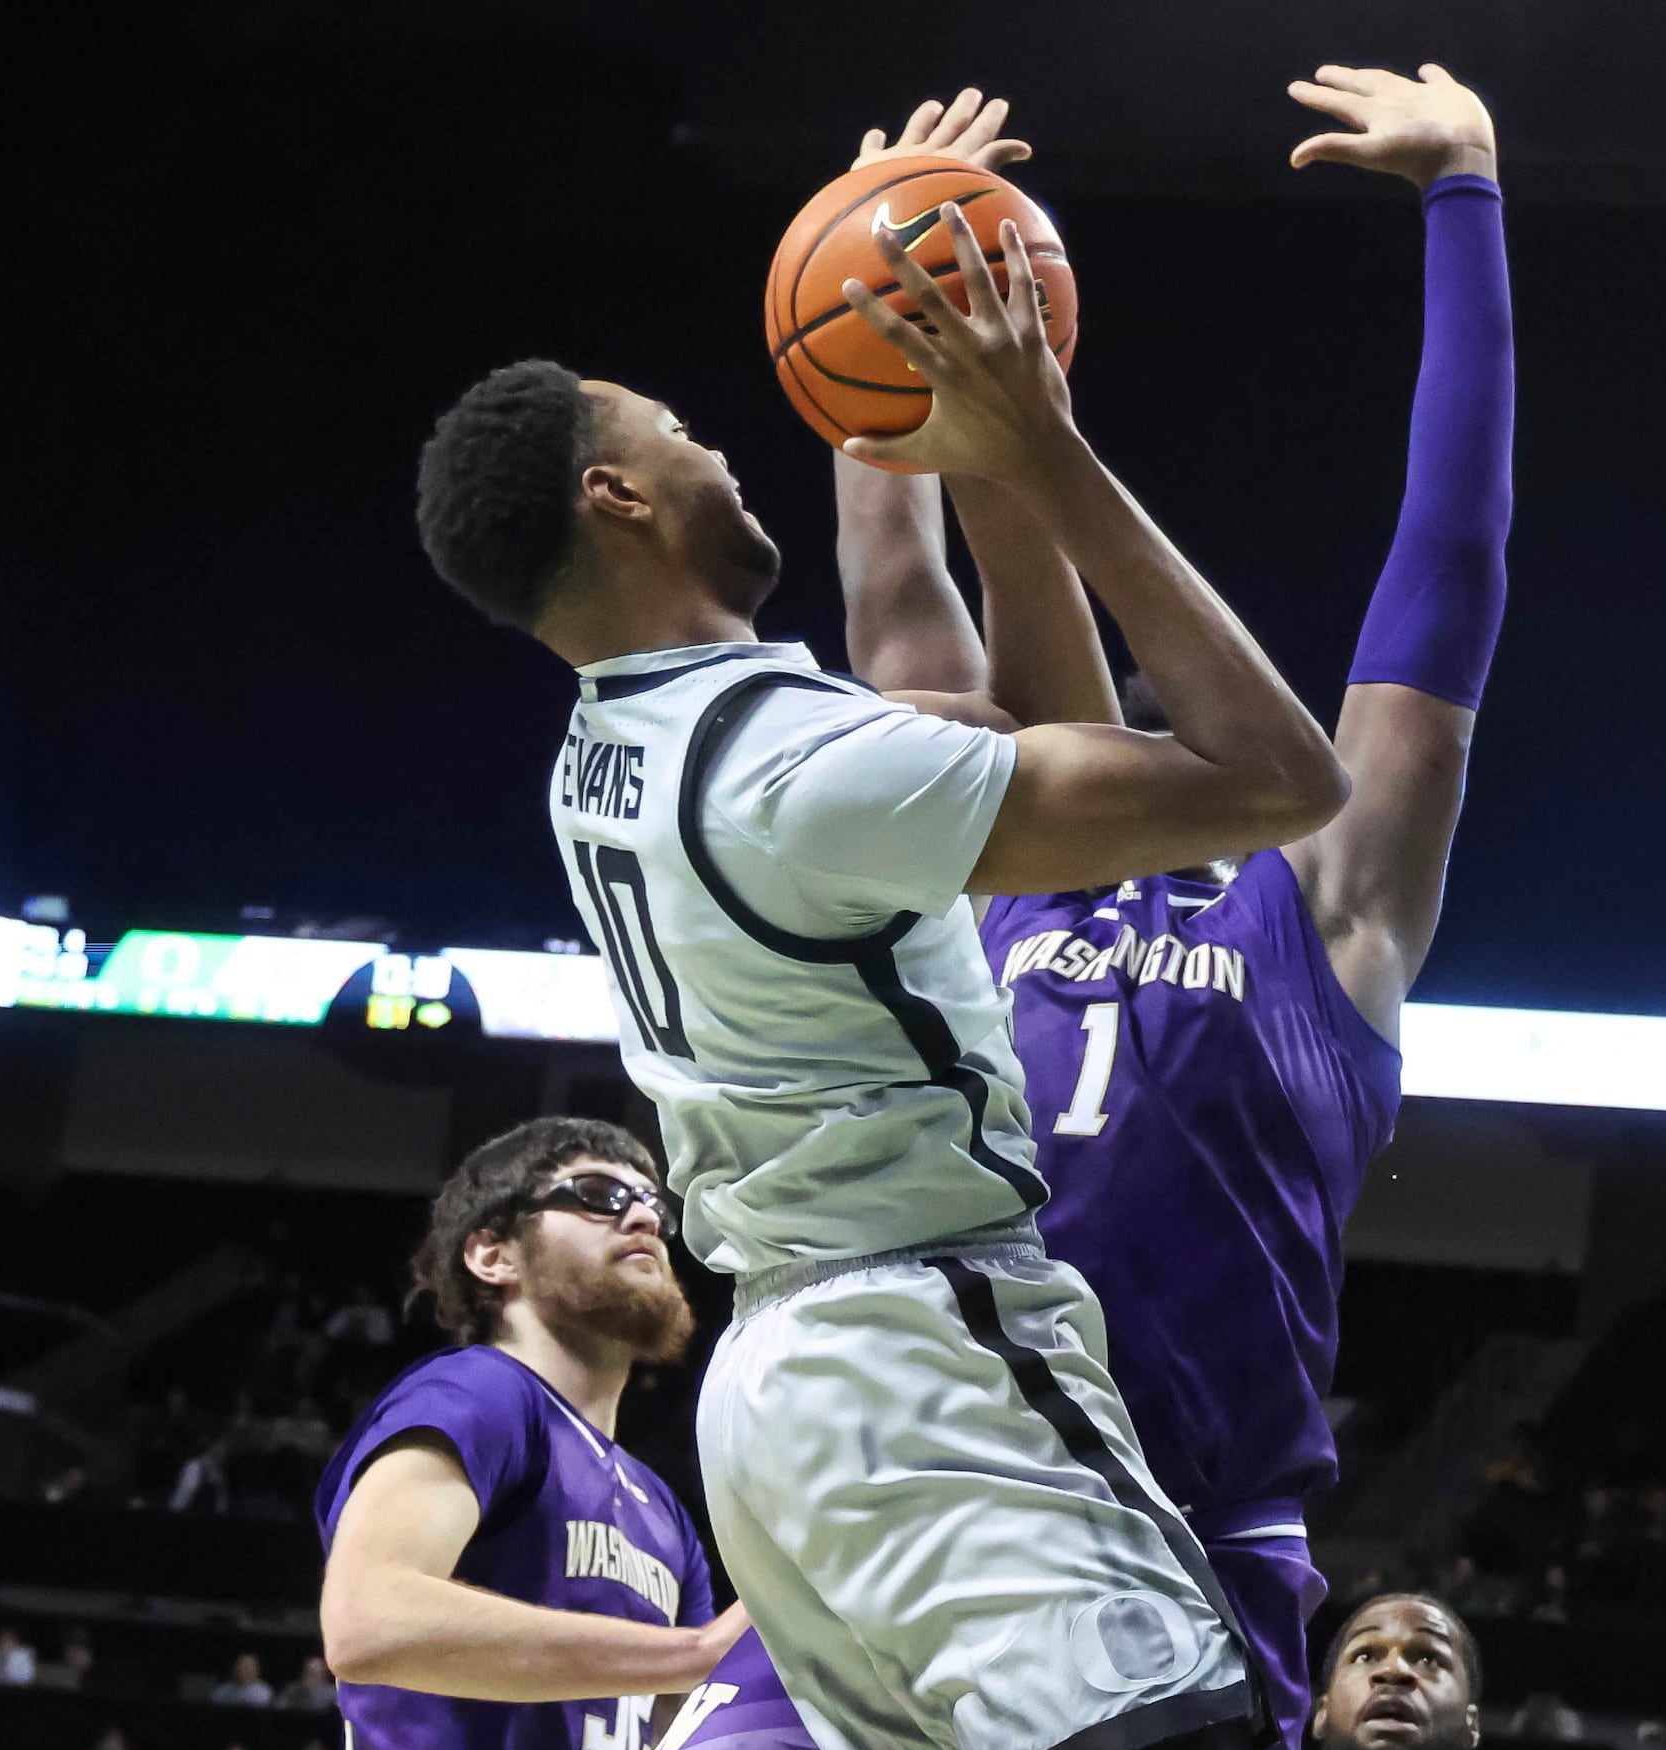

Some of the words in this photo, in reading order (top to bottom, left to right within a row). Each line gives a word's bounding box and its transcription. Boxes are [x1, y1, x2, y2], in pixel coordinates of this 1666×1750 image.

[562, 733, 645, 820] EVANS
[573, 839, 696, 1063] 10
[1052, 1002, 1120, 1137] 1
